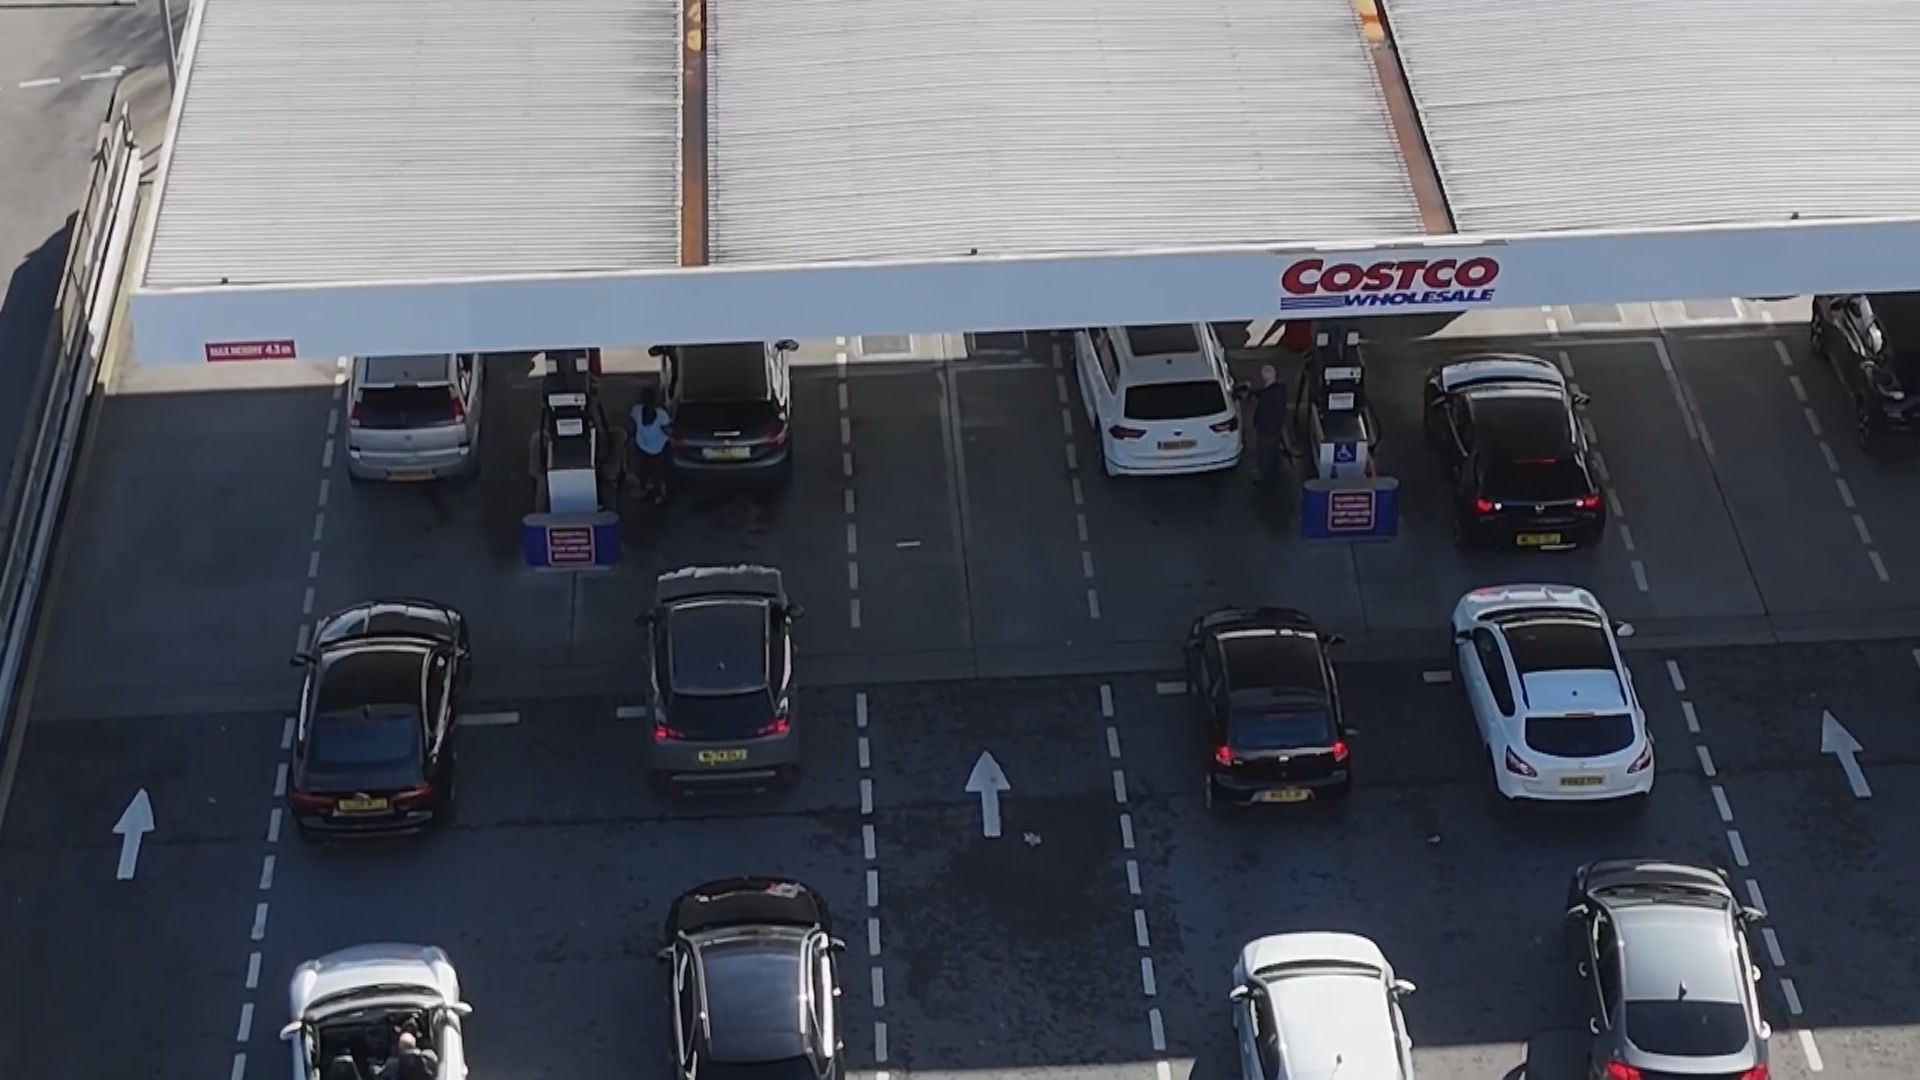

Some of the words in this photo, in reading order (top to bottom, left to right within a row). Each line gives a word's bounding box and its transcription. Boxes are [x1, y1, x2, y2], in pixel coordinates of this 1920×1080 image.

[1282, 257, 1499, 295] COSTCO
[1343, 289, 1495, 307] WHOLESALE
[209, 346, 229, 356] MAX
